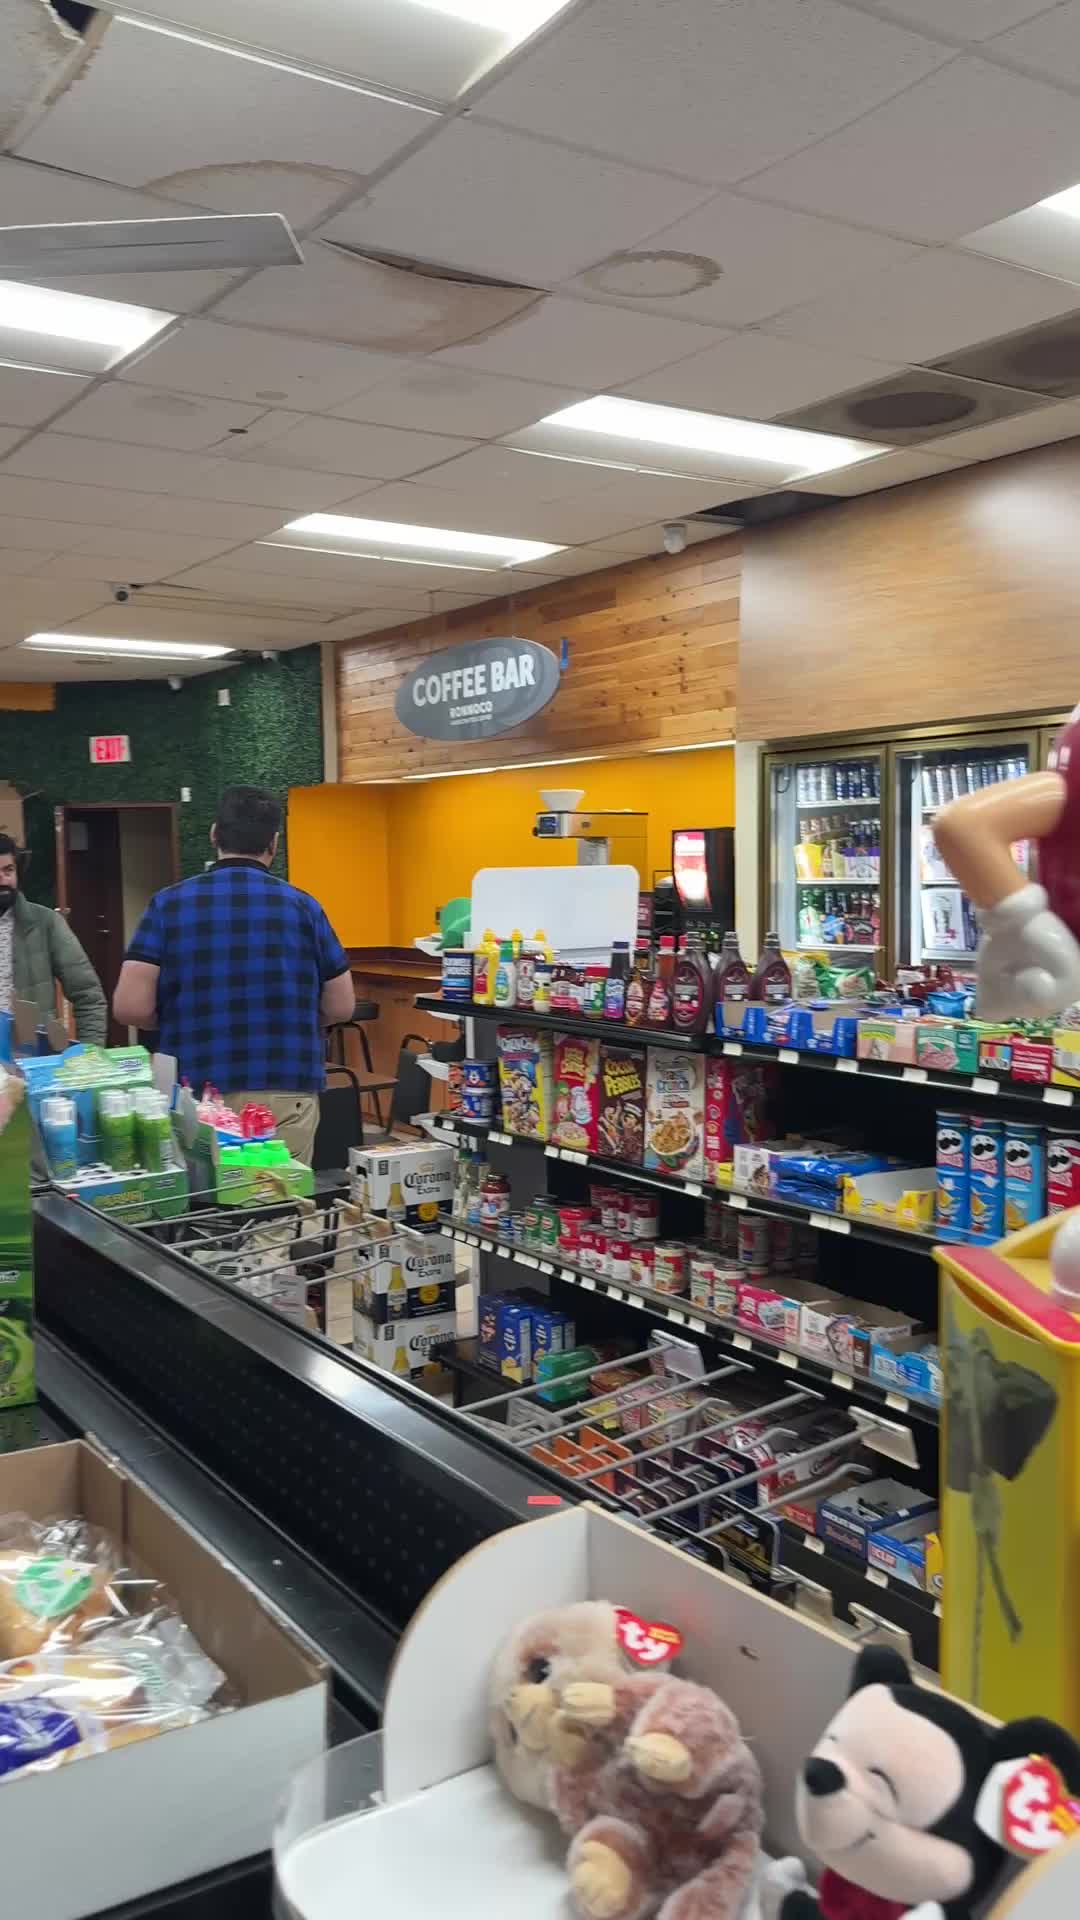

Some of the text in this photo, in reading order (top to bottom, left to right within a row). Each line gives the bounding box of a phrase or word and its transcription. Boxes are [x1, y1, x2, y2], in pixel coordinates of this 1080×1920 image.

[412, 654, 536, 707] COFFEE BAR
[95, 738, 124, 762] EXIT
[404, 1171, 451, 1189] Corona
[405, 1253, 452, 1272] Corona
